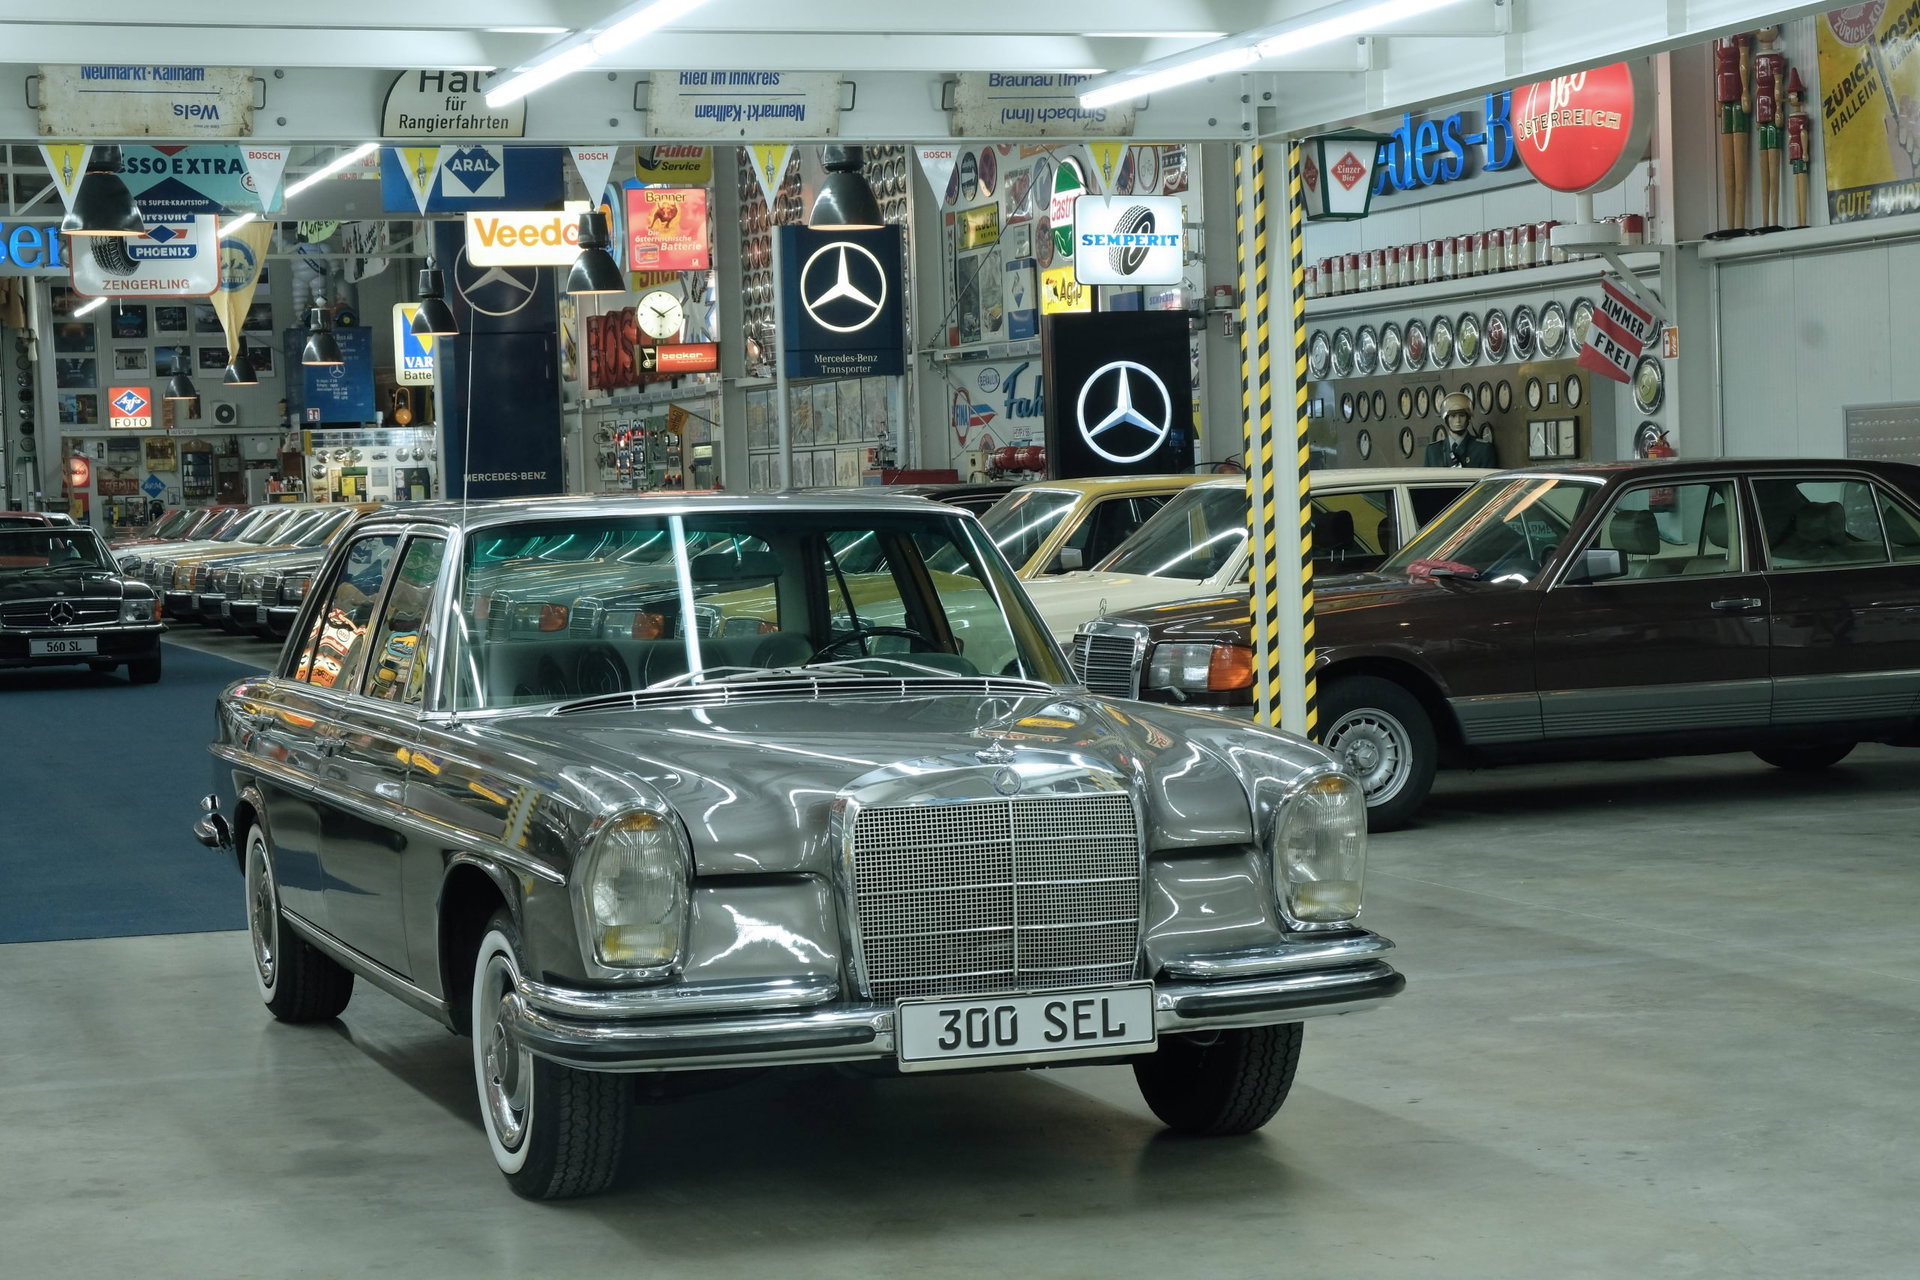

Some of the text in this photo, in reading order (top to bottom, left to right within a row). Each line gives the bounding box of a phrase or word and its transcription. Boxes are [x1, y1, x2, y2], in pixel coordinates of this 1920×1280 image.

[988, 73, 1053, 87] Braunau
[1823, 51, 1874, 119] ZÜRICH
[445, 96, 467, 111] für
[1831, 76, 1878, 136] HALLEIN
[173, 104, 220, 120] Wels
[399, 114, 509, 133] Rangierfahrten
[248, 151, 281, 161] BOSCH
[578, 153, 609, 161] BOSCH
[923, 151, 952, 159] BOSCH
[120, 157, 244, 175] SSO EXTRA
[452, 159, 494, 172] ARAL
[661, 161, 701, 171] Service
[645, 191, 687, 203] Banner
[1836, 189, 1873, 217] GUTE
[474, 217, 581, 247] Veedo
[1082, 234, 1179, 246] SEMPERIT
[135, 247, 190, 257] PHOENIX
[661, 242, 702, 251] Batterie
[102, 279, 190, 290] ZENGERLING
[1600, 293, 1645, 339] ZIMMER
[1594, 331, 1632, 370] FREI
[404, 356, 433, 368] VAR
[814, 353, 879, 363] Mercedes-Benz
[404, 371, 434, 380] Batte
[821, 365, 872, 375] Transporter
[114, 418, 148, 427] FOTO
[46, 640, 82, 653] 560 SL
[938, 998, 1126, 1051] 300 SEL
